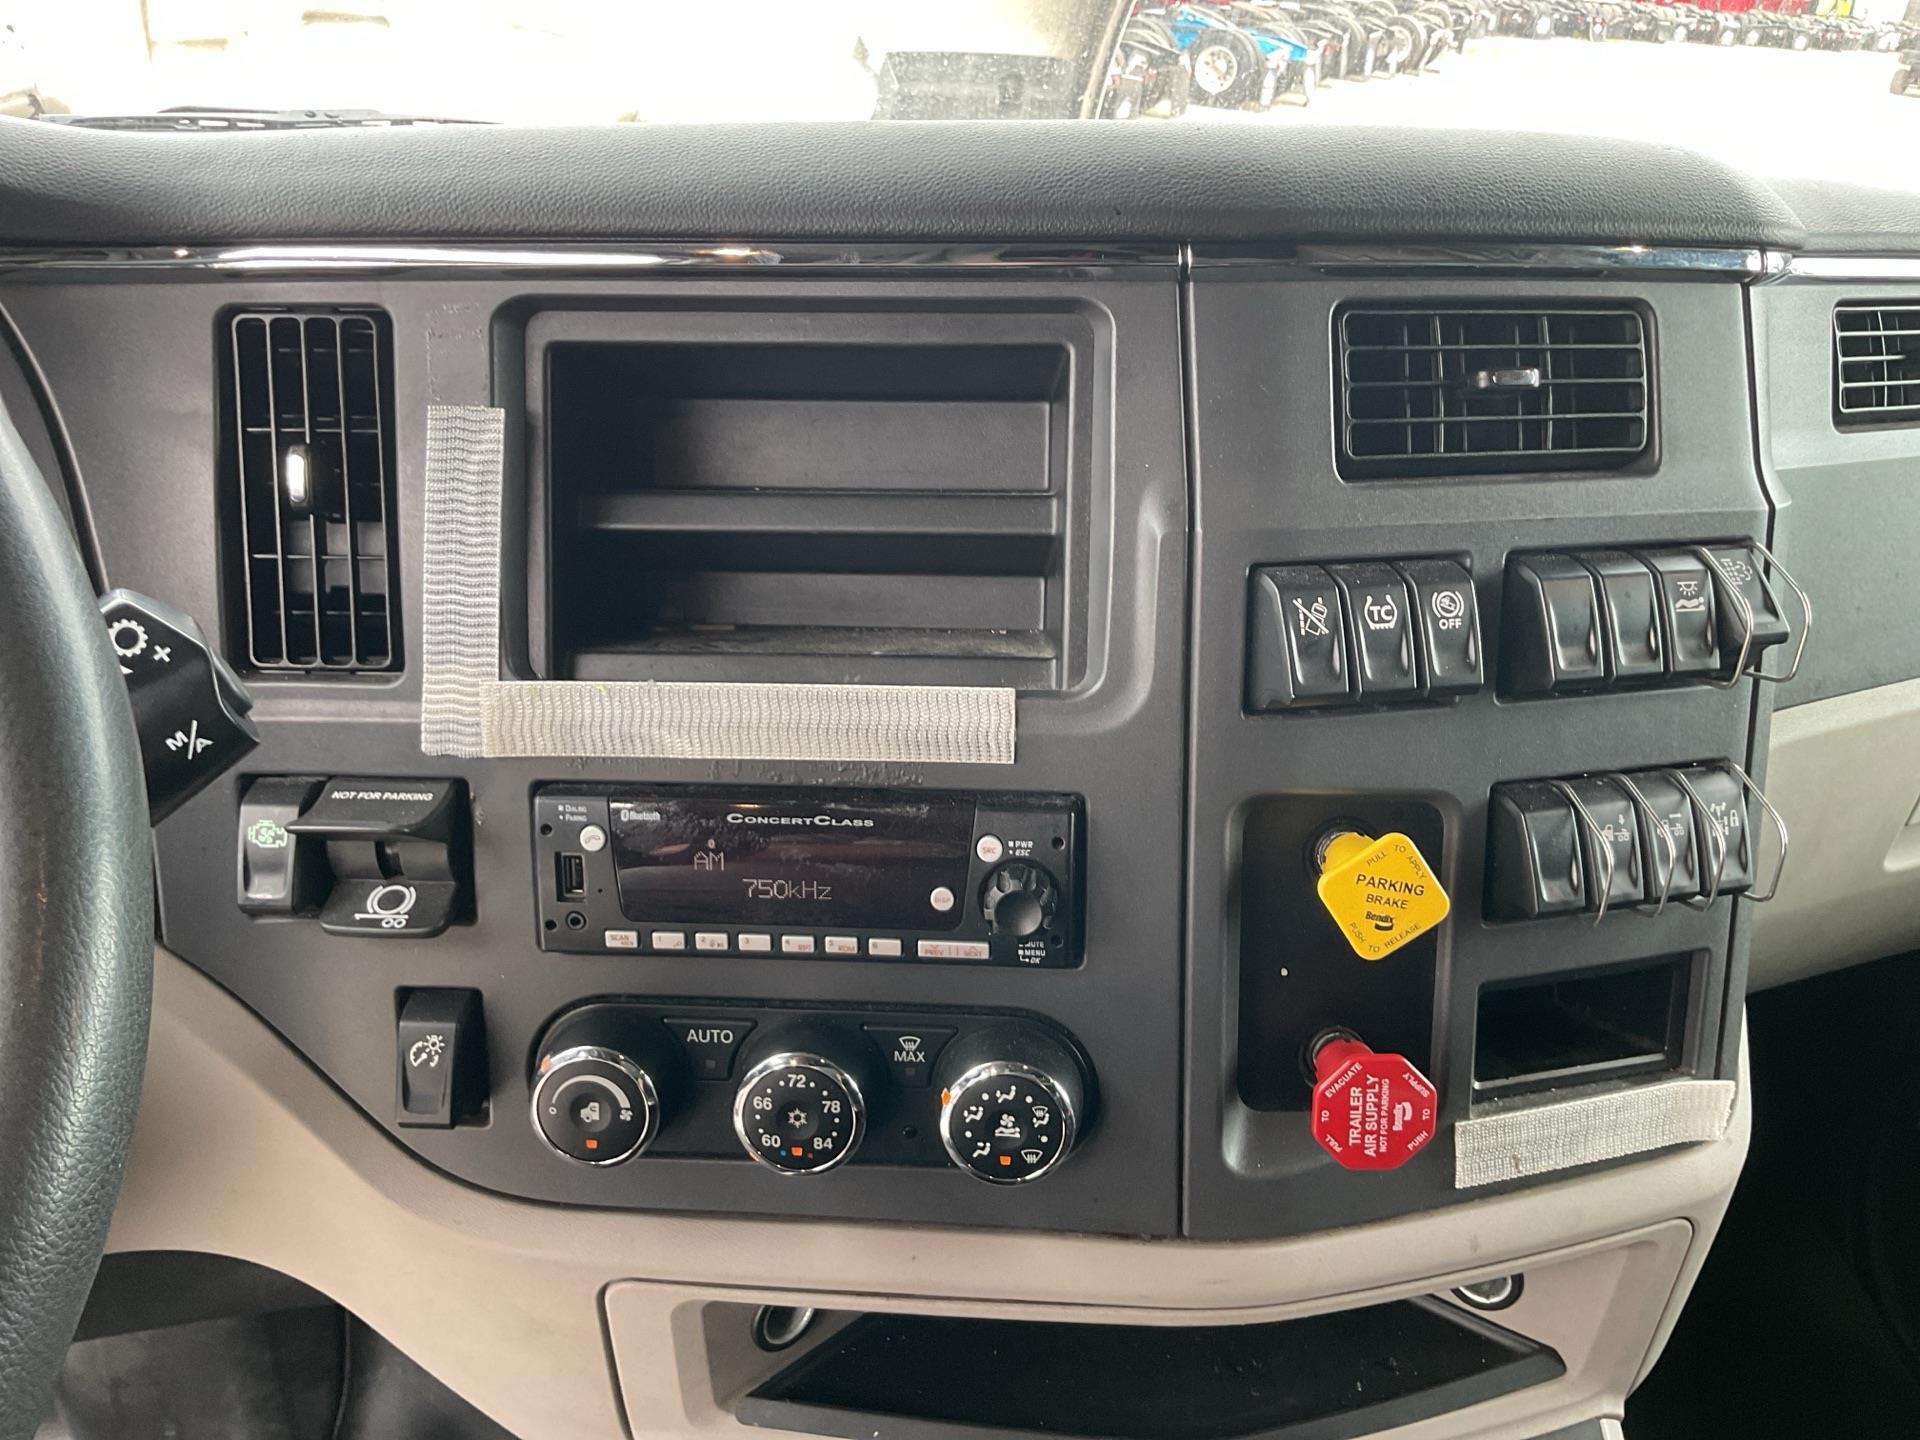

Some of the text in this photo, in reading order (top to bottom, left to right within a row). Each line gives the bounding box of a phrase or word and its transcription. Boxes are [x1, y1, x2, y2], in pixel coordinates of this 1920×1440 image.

[1369, 605, 1393, 620] TC
[1438, 618, 1462, 630] OFF
[165, 719, 214, 760] M/A
[331, 790, 434, 801] NOT FOR PARKING
[1014, 840, 1034, 849] PWR
[1015, 849, 1031, 857] ESC
[693, 851, 725, 872] AM
[1366, 844, 1427, 880] PULL TO APPLY
[741, 877, 833, 900] 750kHz
[1355, 873, 1425, 896] PARKING
[1366, 893, 1409, 909] BRAKE
[1365, 911, 1395, 924] Bendix
[1350, 922, 1421, 953] PUSH TO RELEASE
[1025, 949, 1046, 957] MENU
[686, 1029, 734, 1044] AUTO
[893, 1051, 926, 1063] MAX
[787, 1074, 806, 1088] 72
[1324, 1062, 1363, 1098] EVACUATE
[753, 1096, 773, 1110] 66
[821, 1100, 841, 1114] 78
[1321, 1110, 1330, 1122] TO
[1349, 1086, 1363, 1146] TRAILER
[1364, 1074, 1380, 1157] AIR SUPPLY
[1379, 1078, 1390, 1153] NOT FOR PARKING
[1402, 1072, 1431, 1151] PUSH TO SUPPLY
[761, 1134, 781, 1148] 60
[813, 1136, 833, 1150] 84
